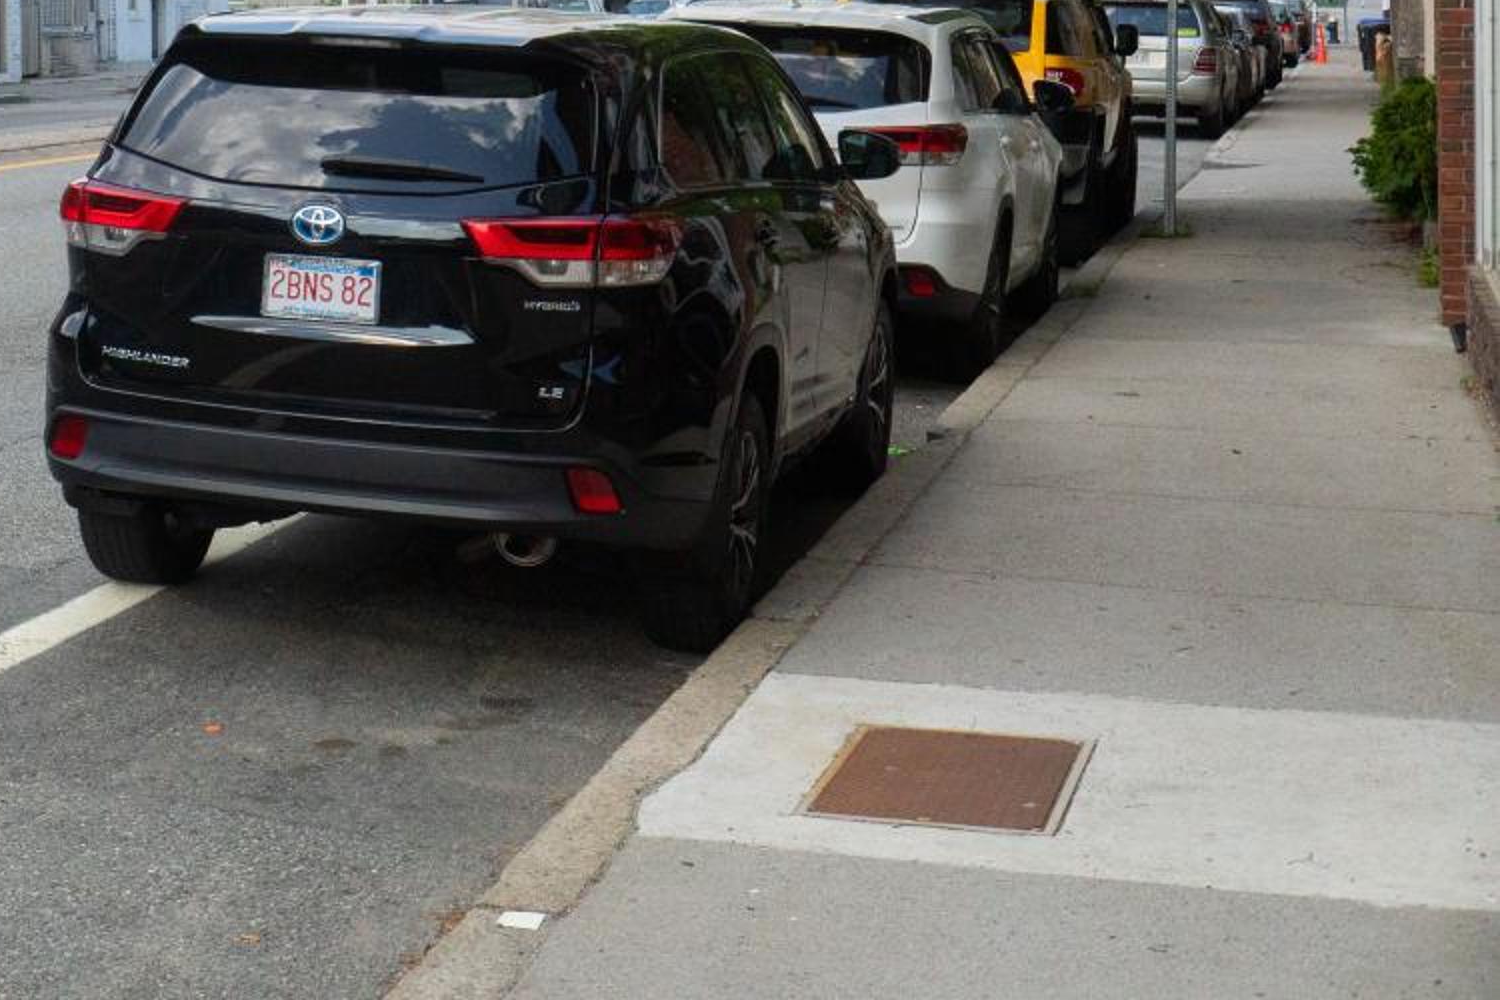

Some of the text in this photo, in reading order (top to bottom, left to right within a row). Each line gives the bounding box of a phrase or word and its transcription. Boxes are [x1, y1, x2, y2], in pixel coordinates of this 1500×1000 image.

[272, 269, 373, 307] 2BNS 82
[101, 345, 190, 369] HIGHLANDER
[538, 387, 564, 399] LE
